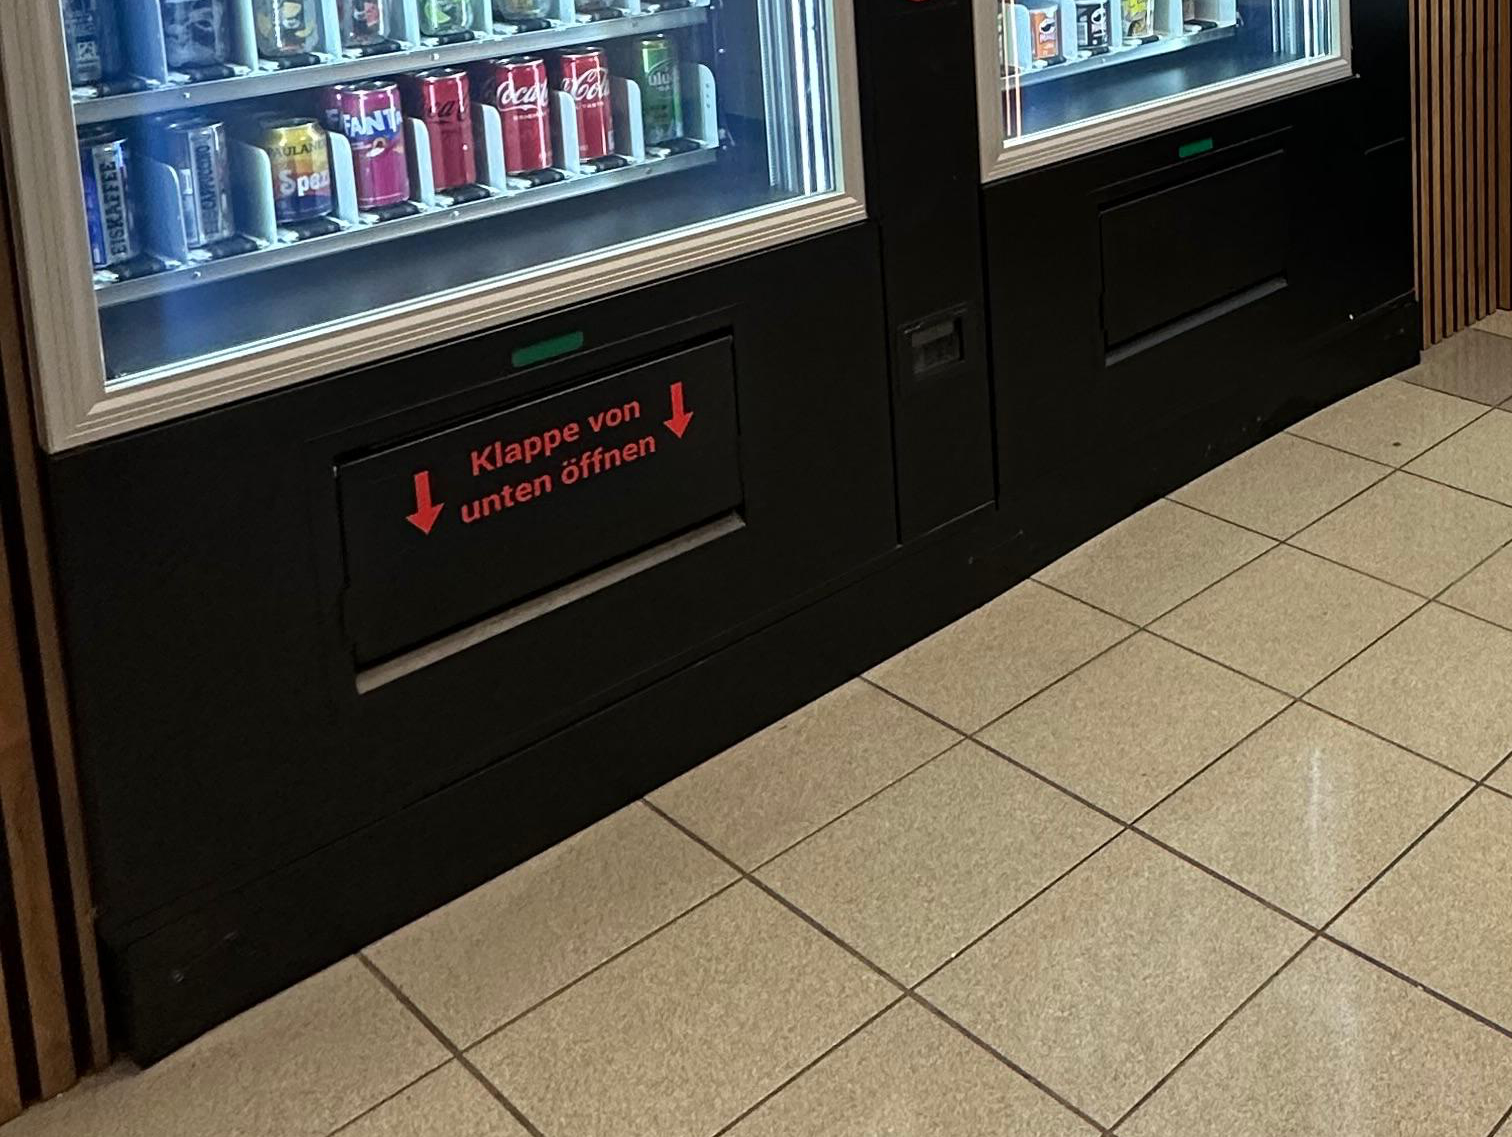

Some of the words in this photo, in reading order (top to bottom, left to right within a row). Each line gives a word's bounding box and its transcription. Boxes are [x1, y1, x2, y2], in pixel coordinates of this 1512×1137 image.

[100, 161, 128, 255] EISKAFFEE
[461, 471, 552, 524] unten
[561, 434, 657, 485] öffnen
[470, 419, 580, 477] Klappe
[588, 399, 641, 434] von
